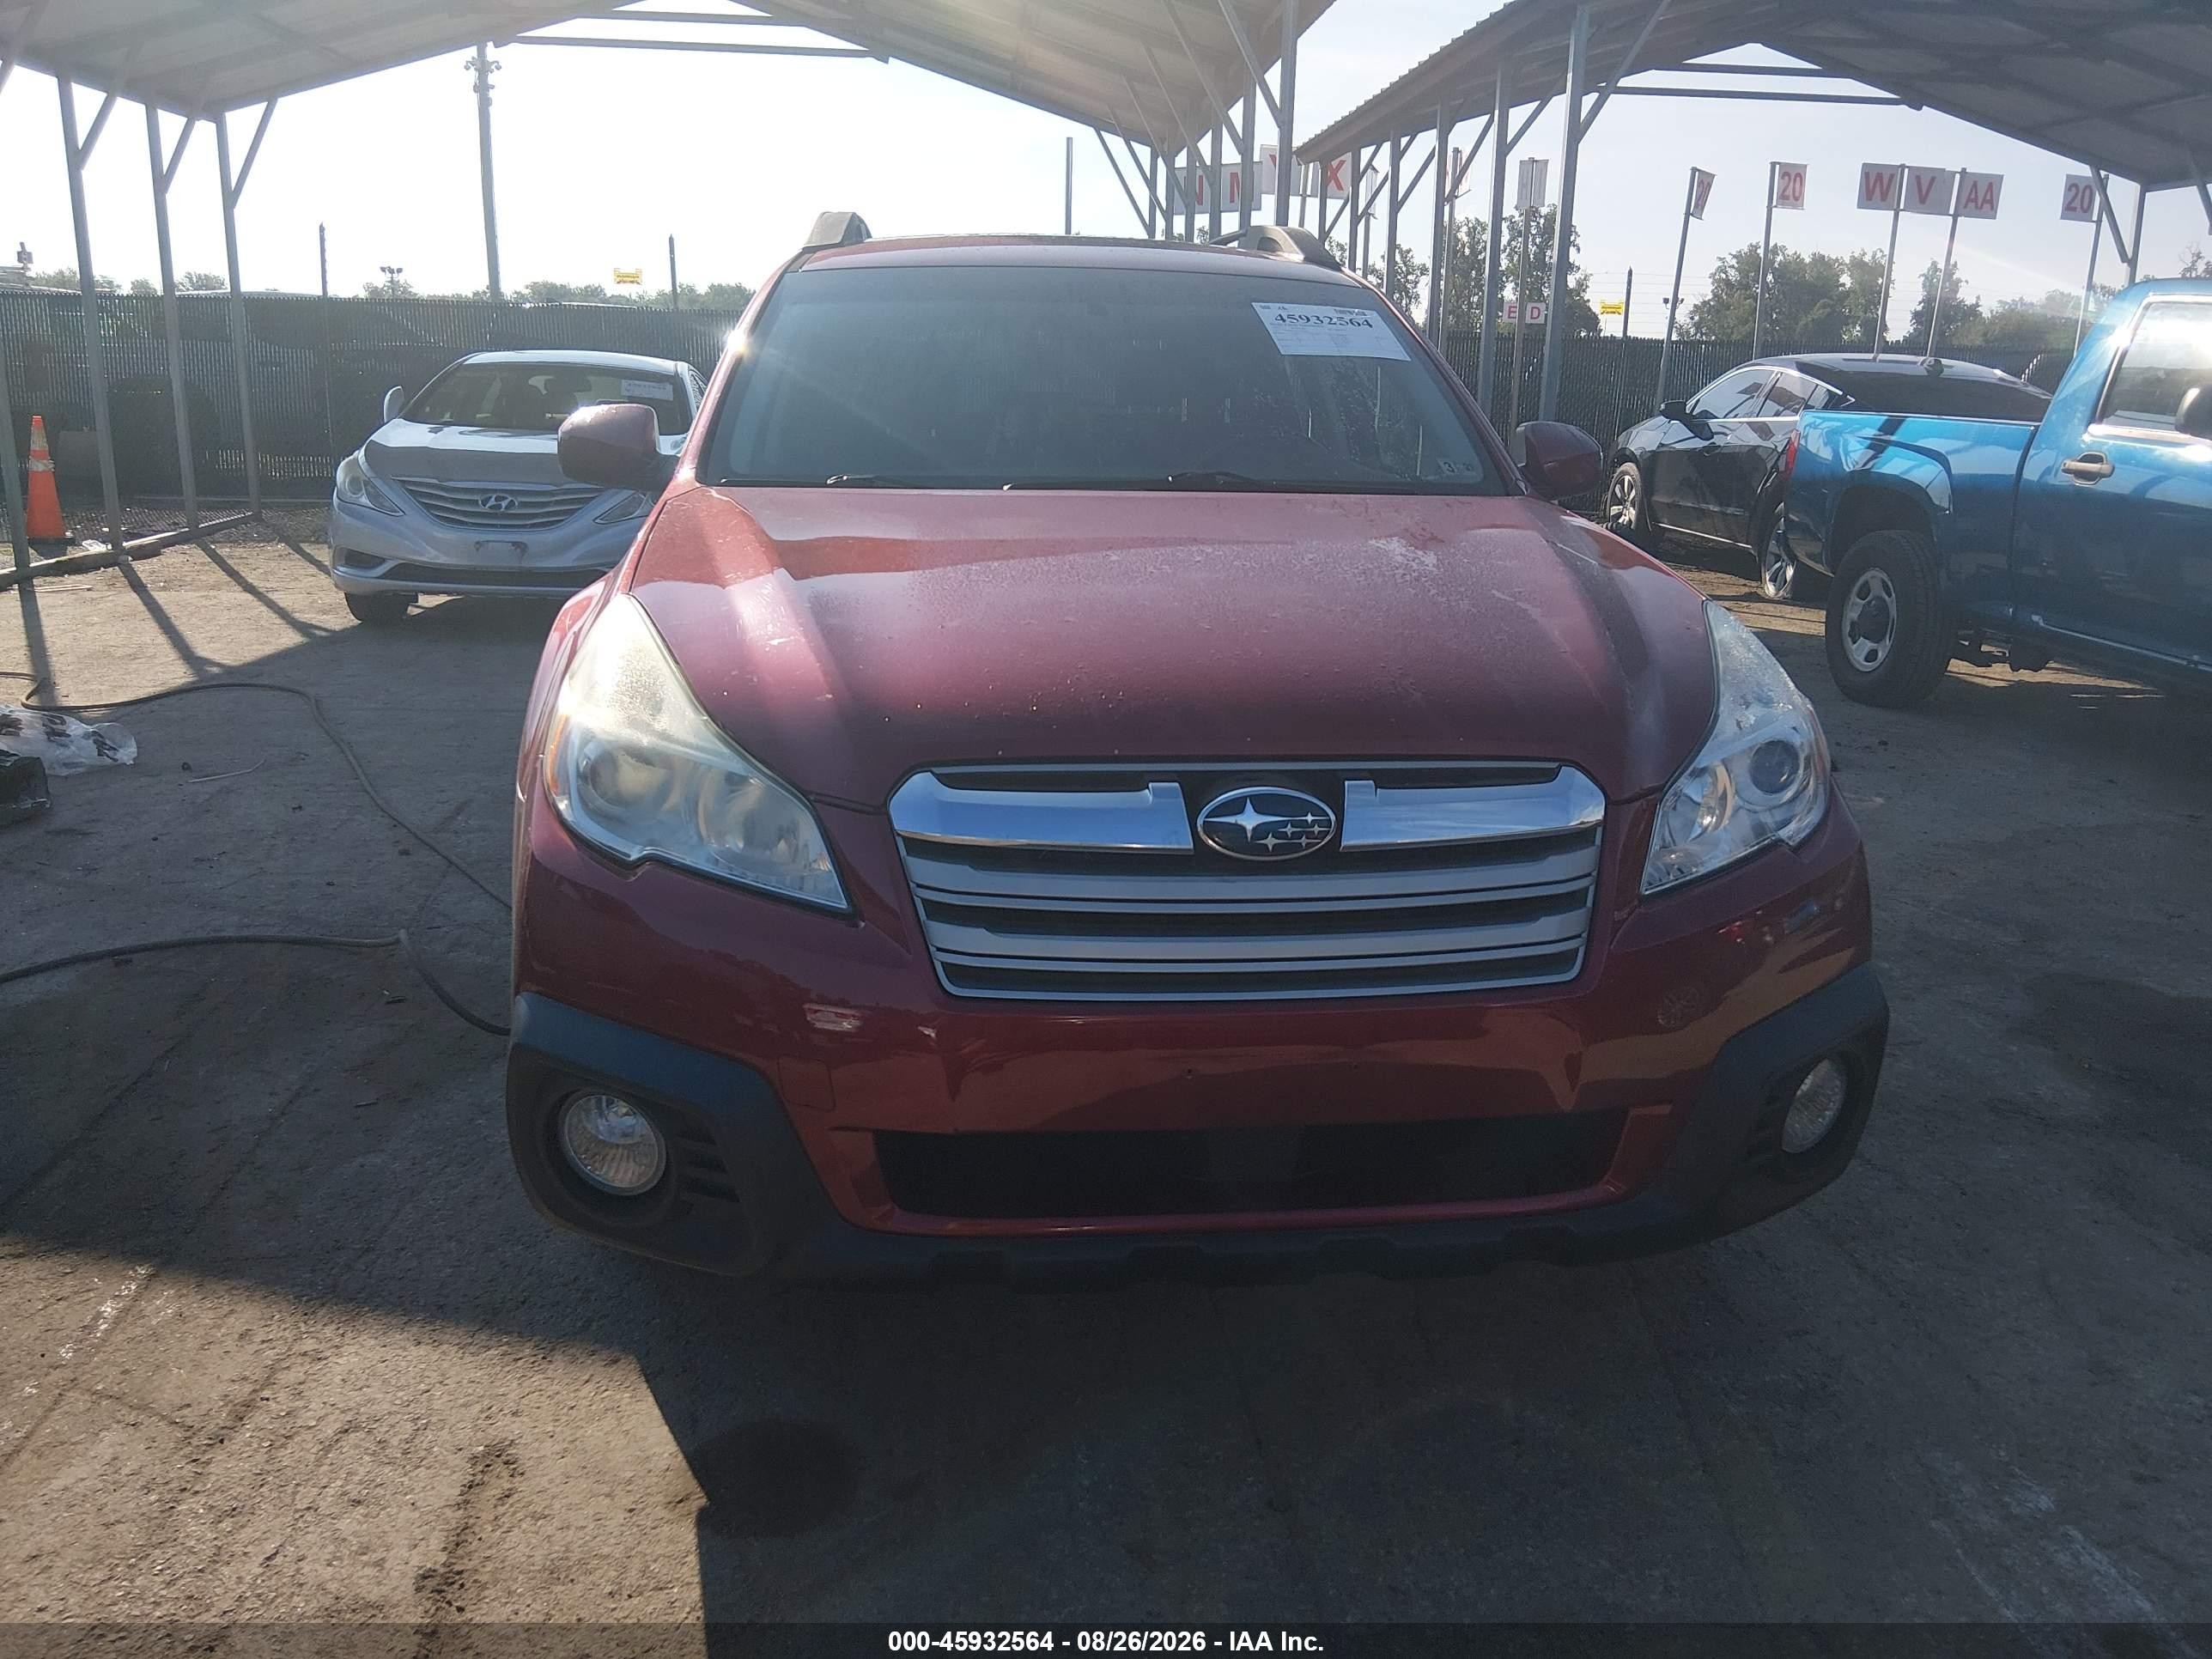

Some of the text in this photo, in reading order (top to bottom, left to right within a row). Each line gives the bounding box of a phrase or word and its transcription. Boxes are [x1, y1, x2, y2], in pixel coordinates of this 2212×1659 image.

[1778, 171, 1803, 202] 20
[1863, 171, 1896, 203] W
[1915, 174, 1936, 205] V
[1963, 179, 1995, 211] AA
[2063, 183, 2094, 214] 20
[1273, 313, 1373, 329] 45932564
[1507, 306, 1518, 319] E
[1530, 306, 1540, 320] D
